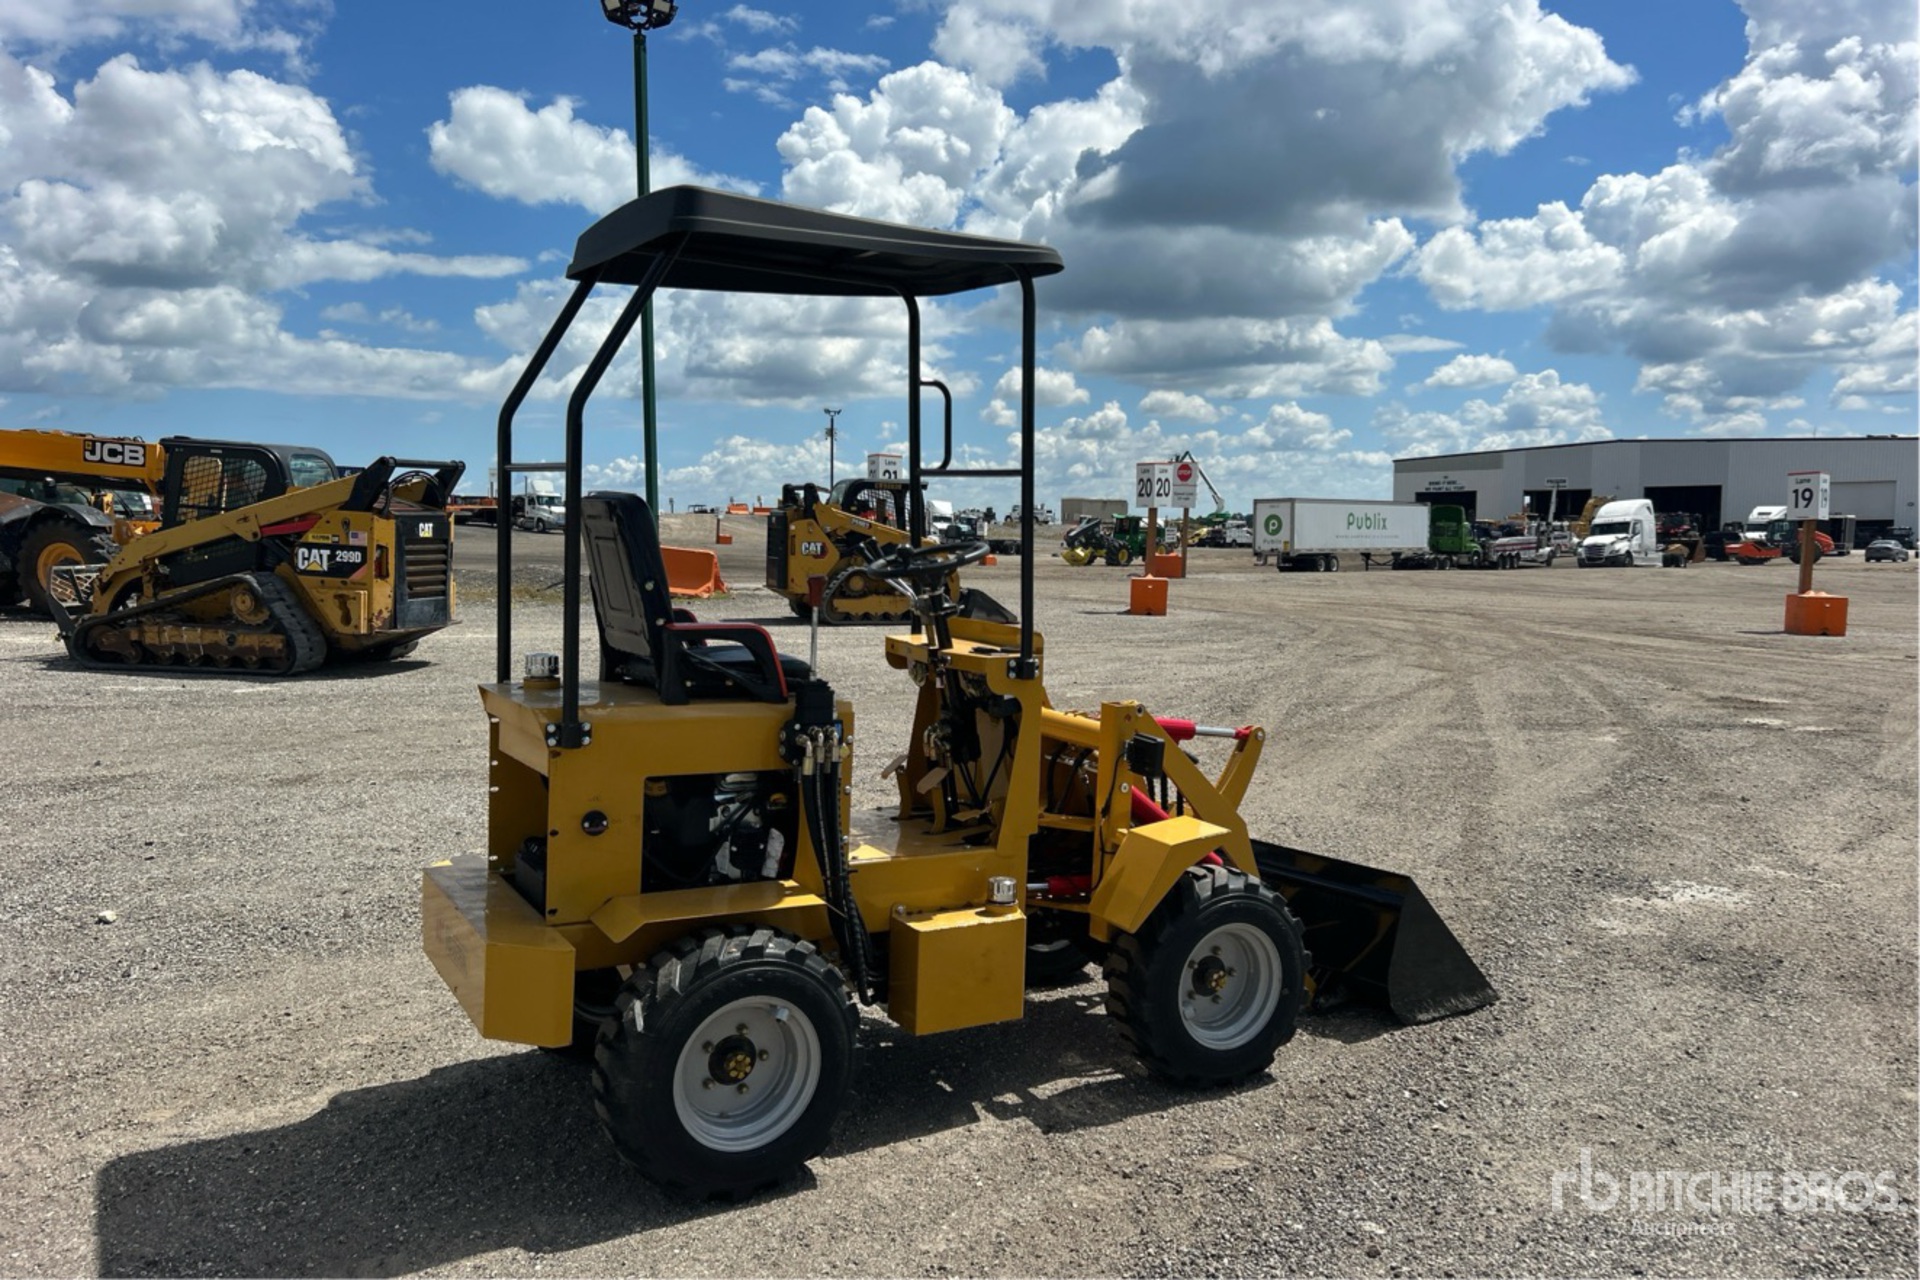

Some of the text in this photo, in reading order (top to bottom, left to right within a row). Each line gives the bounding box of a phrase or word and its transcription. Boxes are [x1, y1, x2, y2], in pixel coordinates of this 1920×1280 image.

[84, 441, 145, 465] JCB
[1137, 477, 1153, 498] 20
[1156, 477, 1171, 498] 20
[1795, 477, 1812, 485] Lane
[1792, 487, 1814, 509] 19
[418, 522, 434, 537] CAT
[1346, 512, 1388, 531] Publix
[298, 547, 362, 572] CAT 299D
[801, 542, 823, 556] CAT
